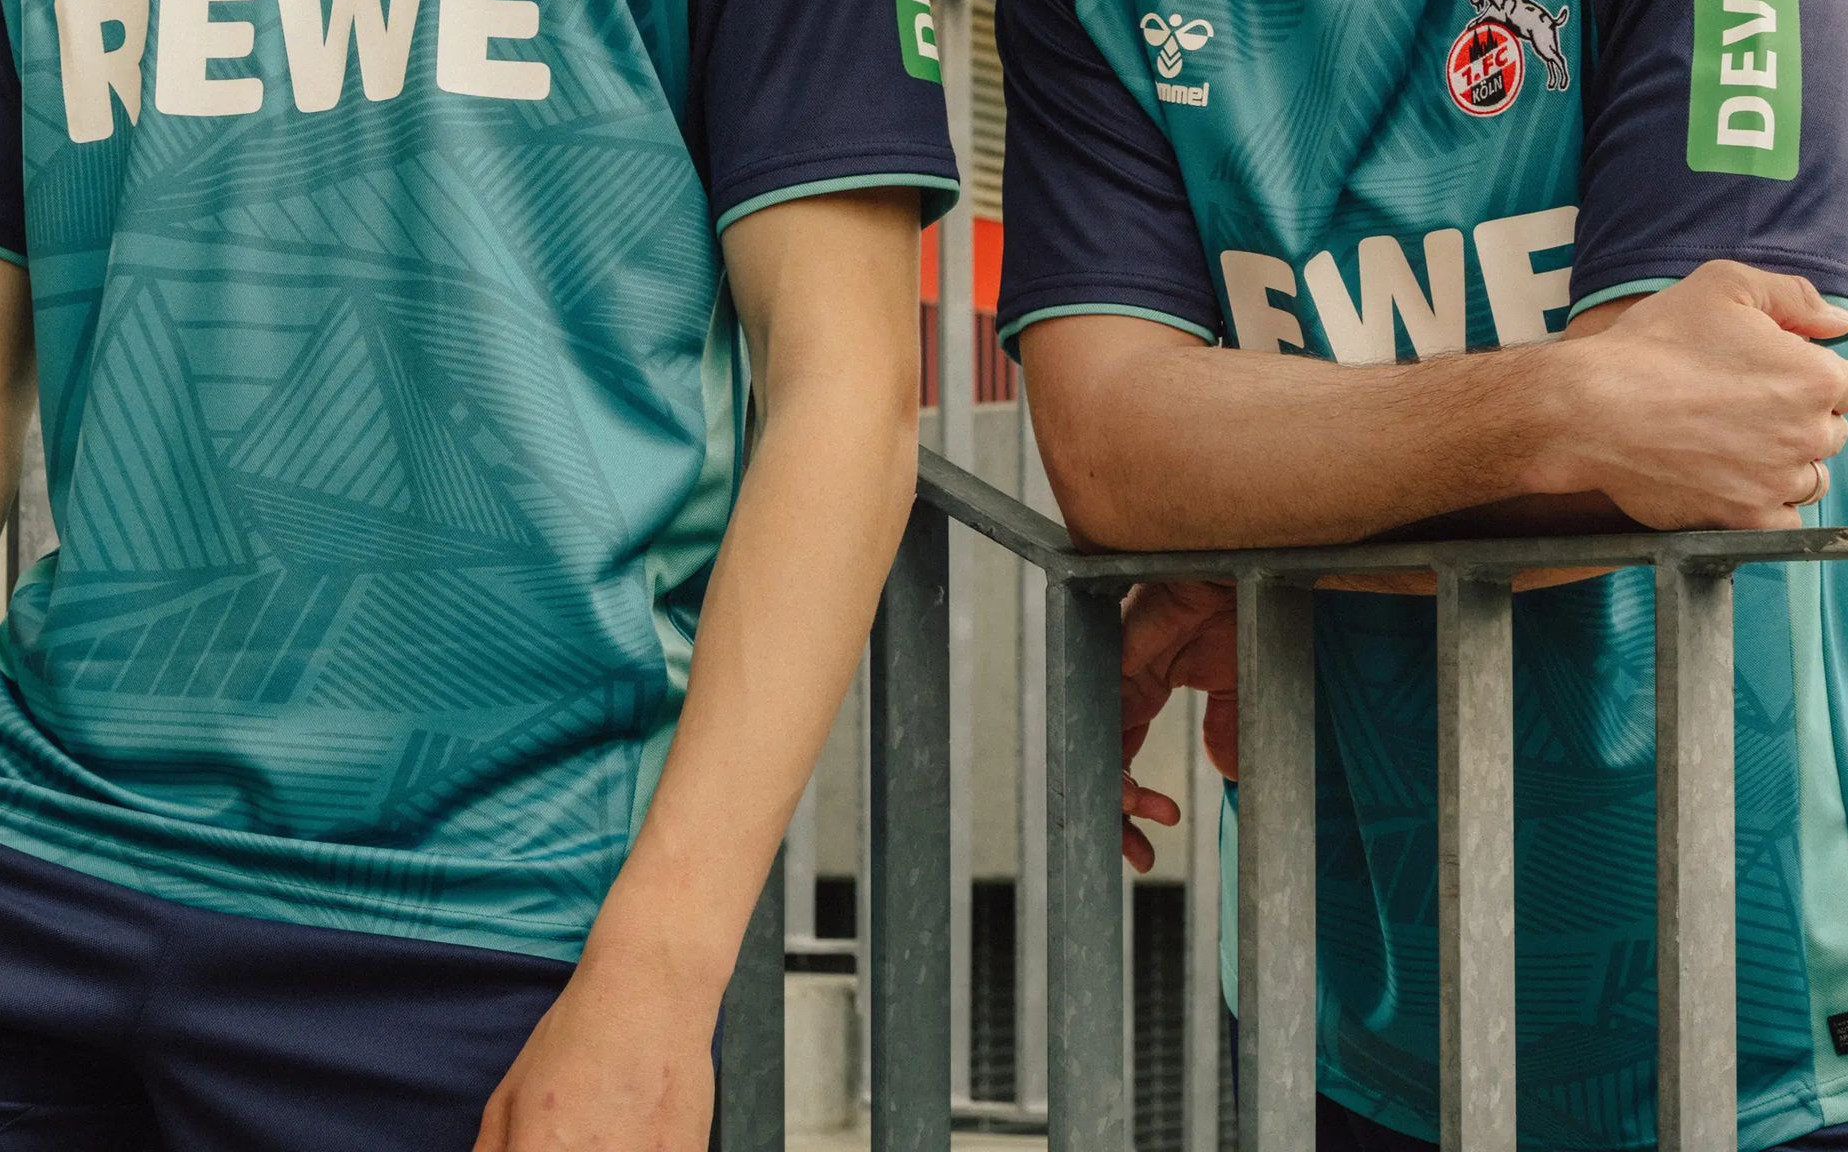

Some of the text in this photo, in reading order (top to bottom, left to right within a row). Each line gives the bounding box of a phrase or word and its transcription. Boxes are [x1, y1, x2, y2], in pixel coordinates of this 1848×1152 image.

[1155, 81, 1210, 107] mmel
[1471, 75, 1503, 105] KÖLN
[1218, 205, 1580, 366] EWE
